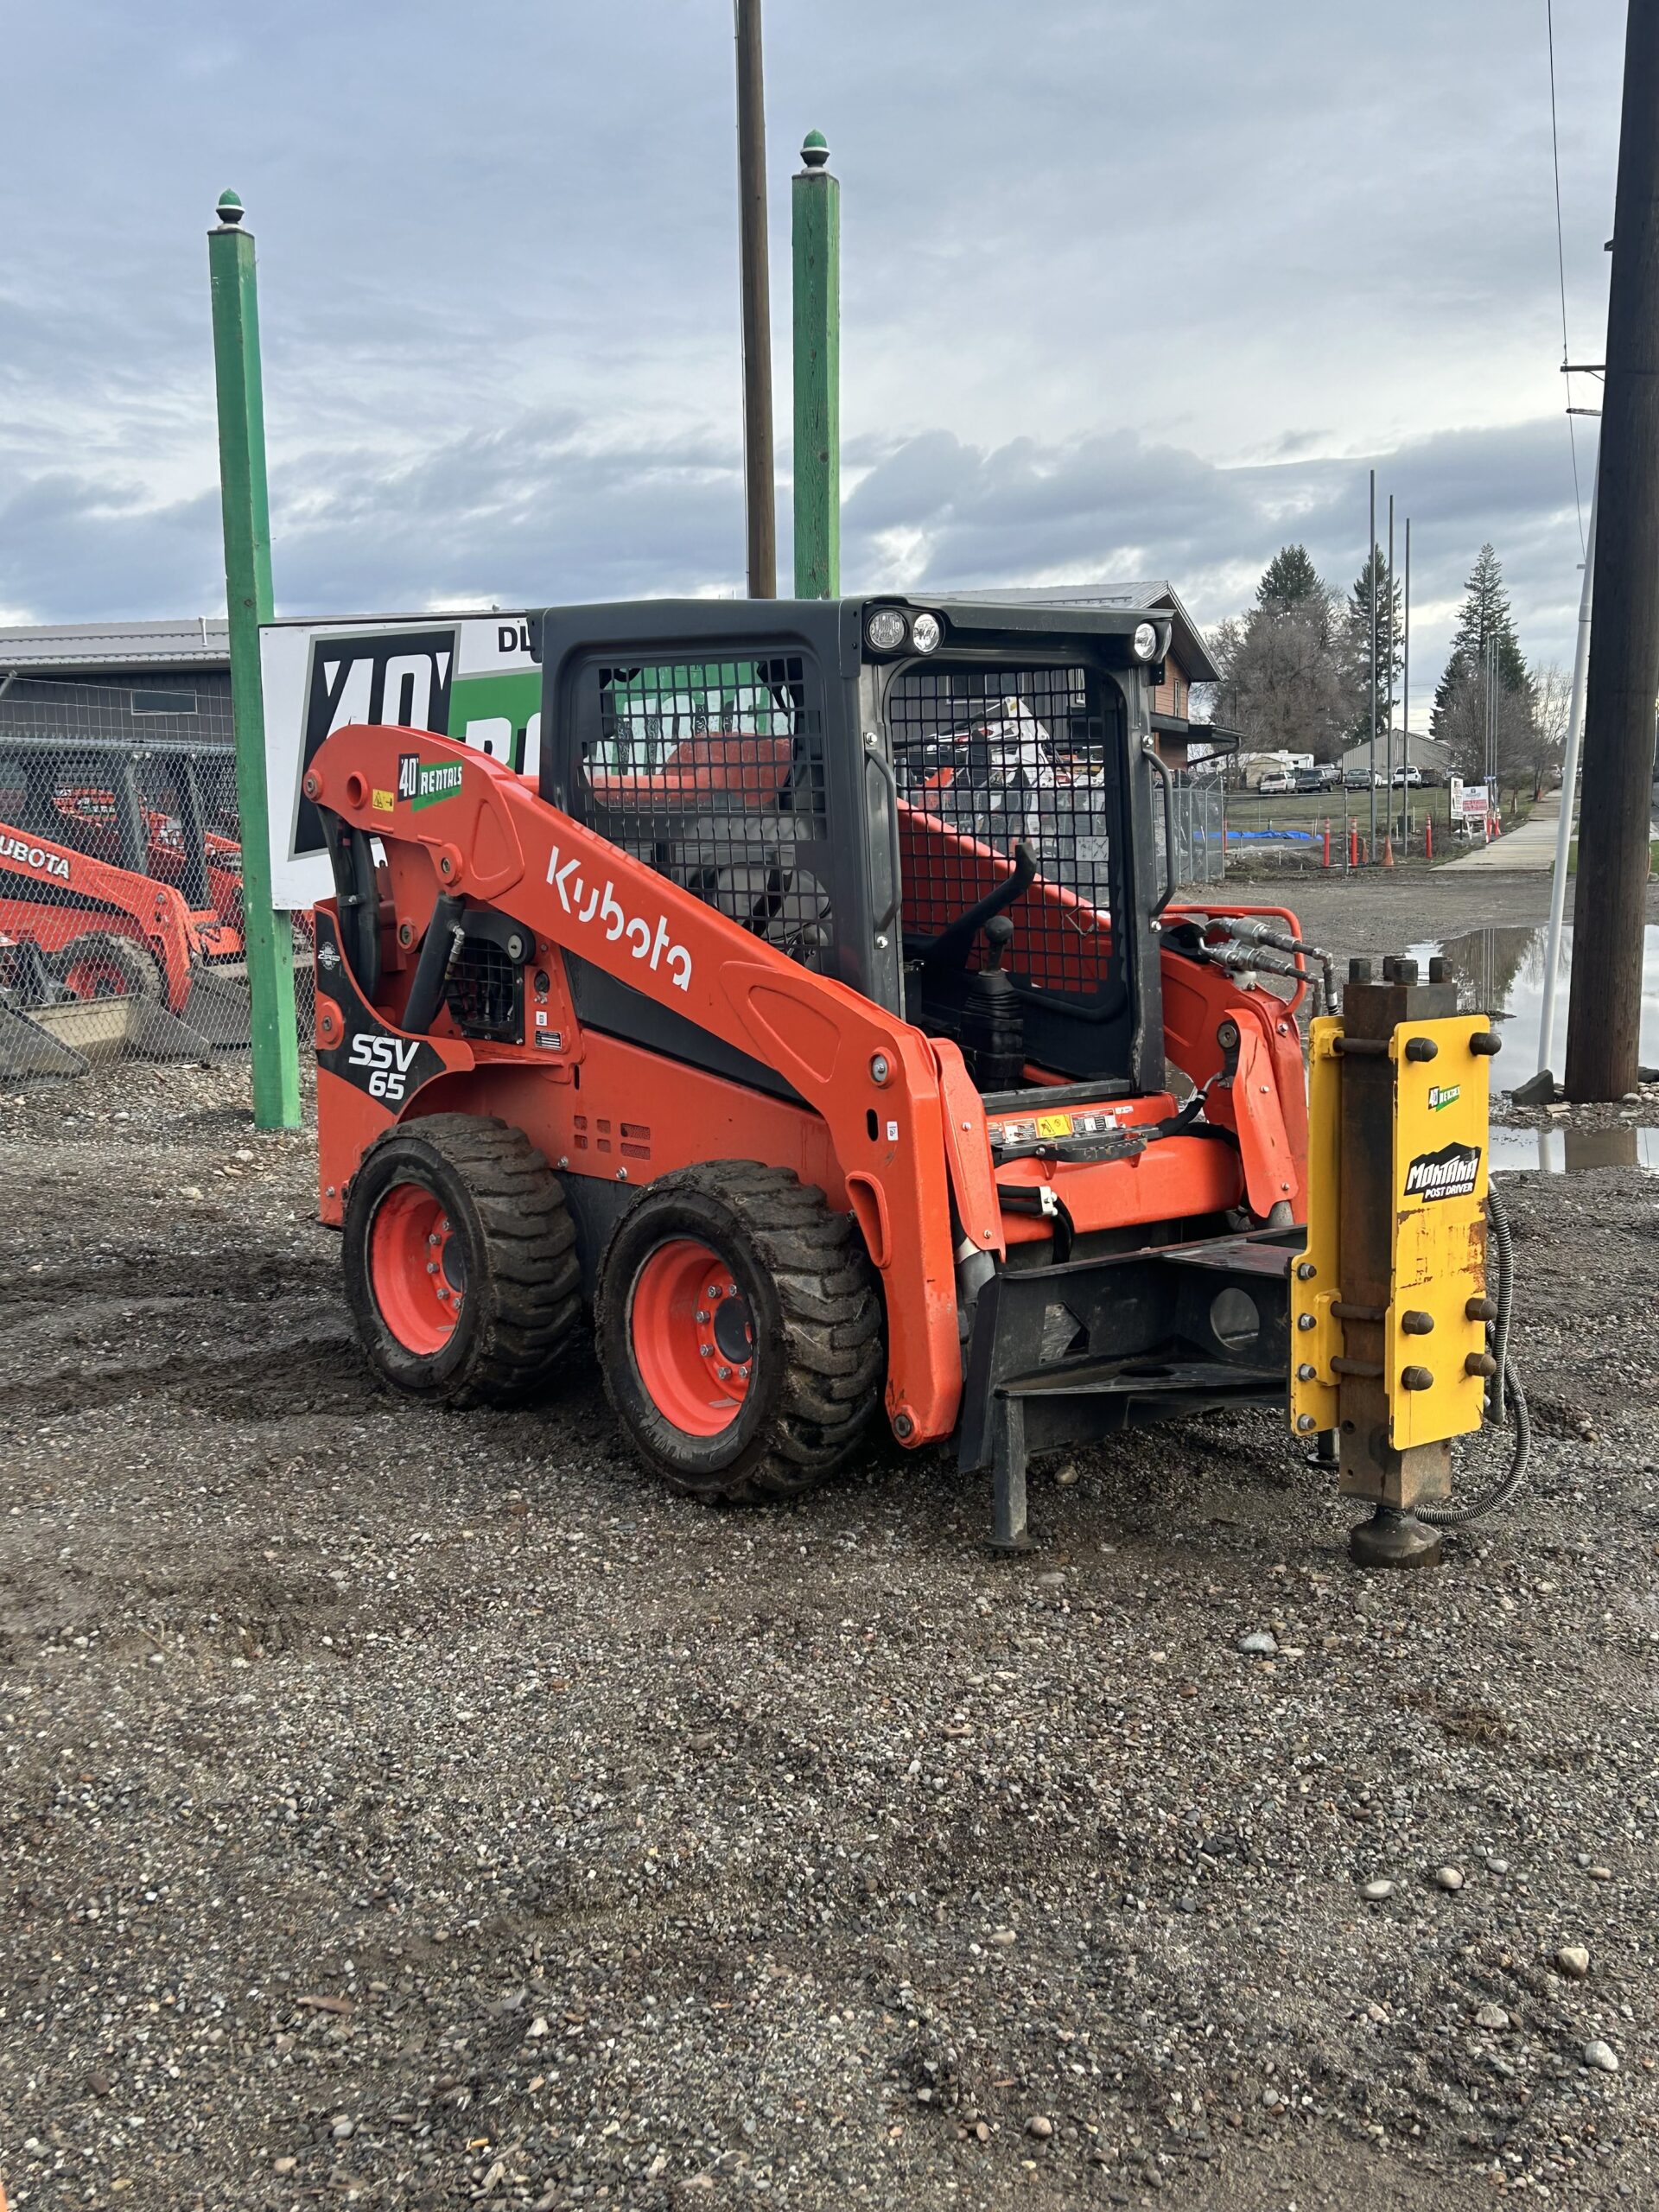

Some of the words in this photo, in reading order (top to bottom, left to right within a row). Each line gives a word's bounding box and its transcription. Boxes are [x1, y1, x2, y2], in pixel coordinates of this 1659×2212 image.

[420, 766, 462, 795] RENTALS
[0, 834, 70, 880] UBOTA
[546, 845, 692, 992] Kubota
[348, 1033, 420, 1072] SSV
[368, 1071, 406, 1100] 65
[1406, 1154, 1478, 1191] MONTANA
[1424, 1186, 1446, 1199] POST
[1445, 1182, 1474, 1196] DRIVER
